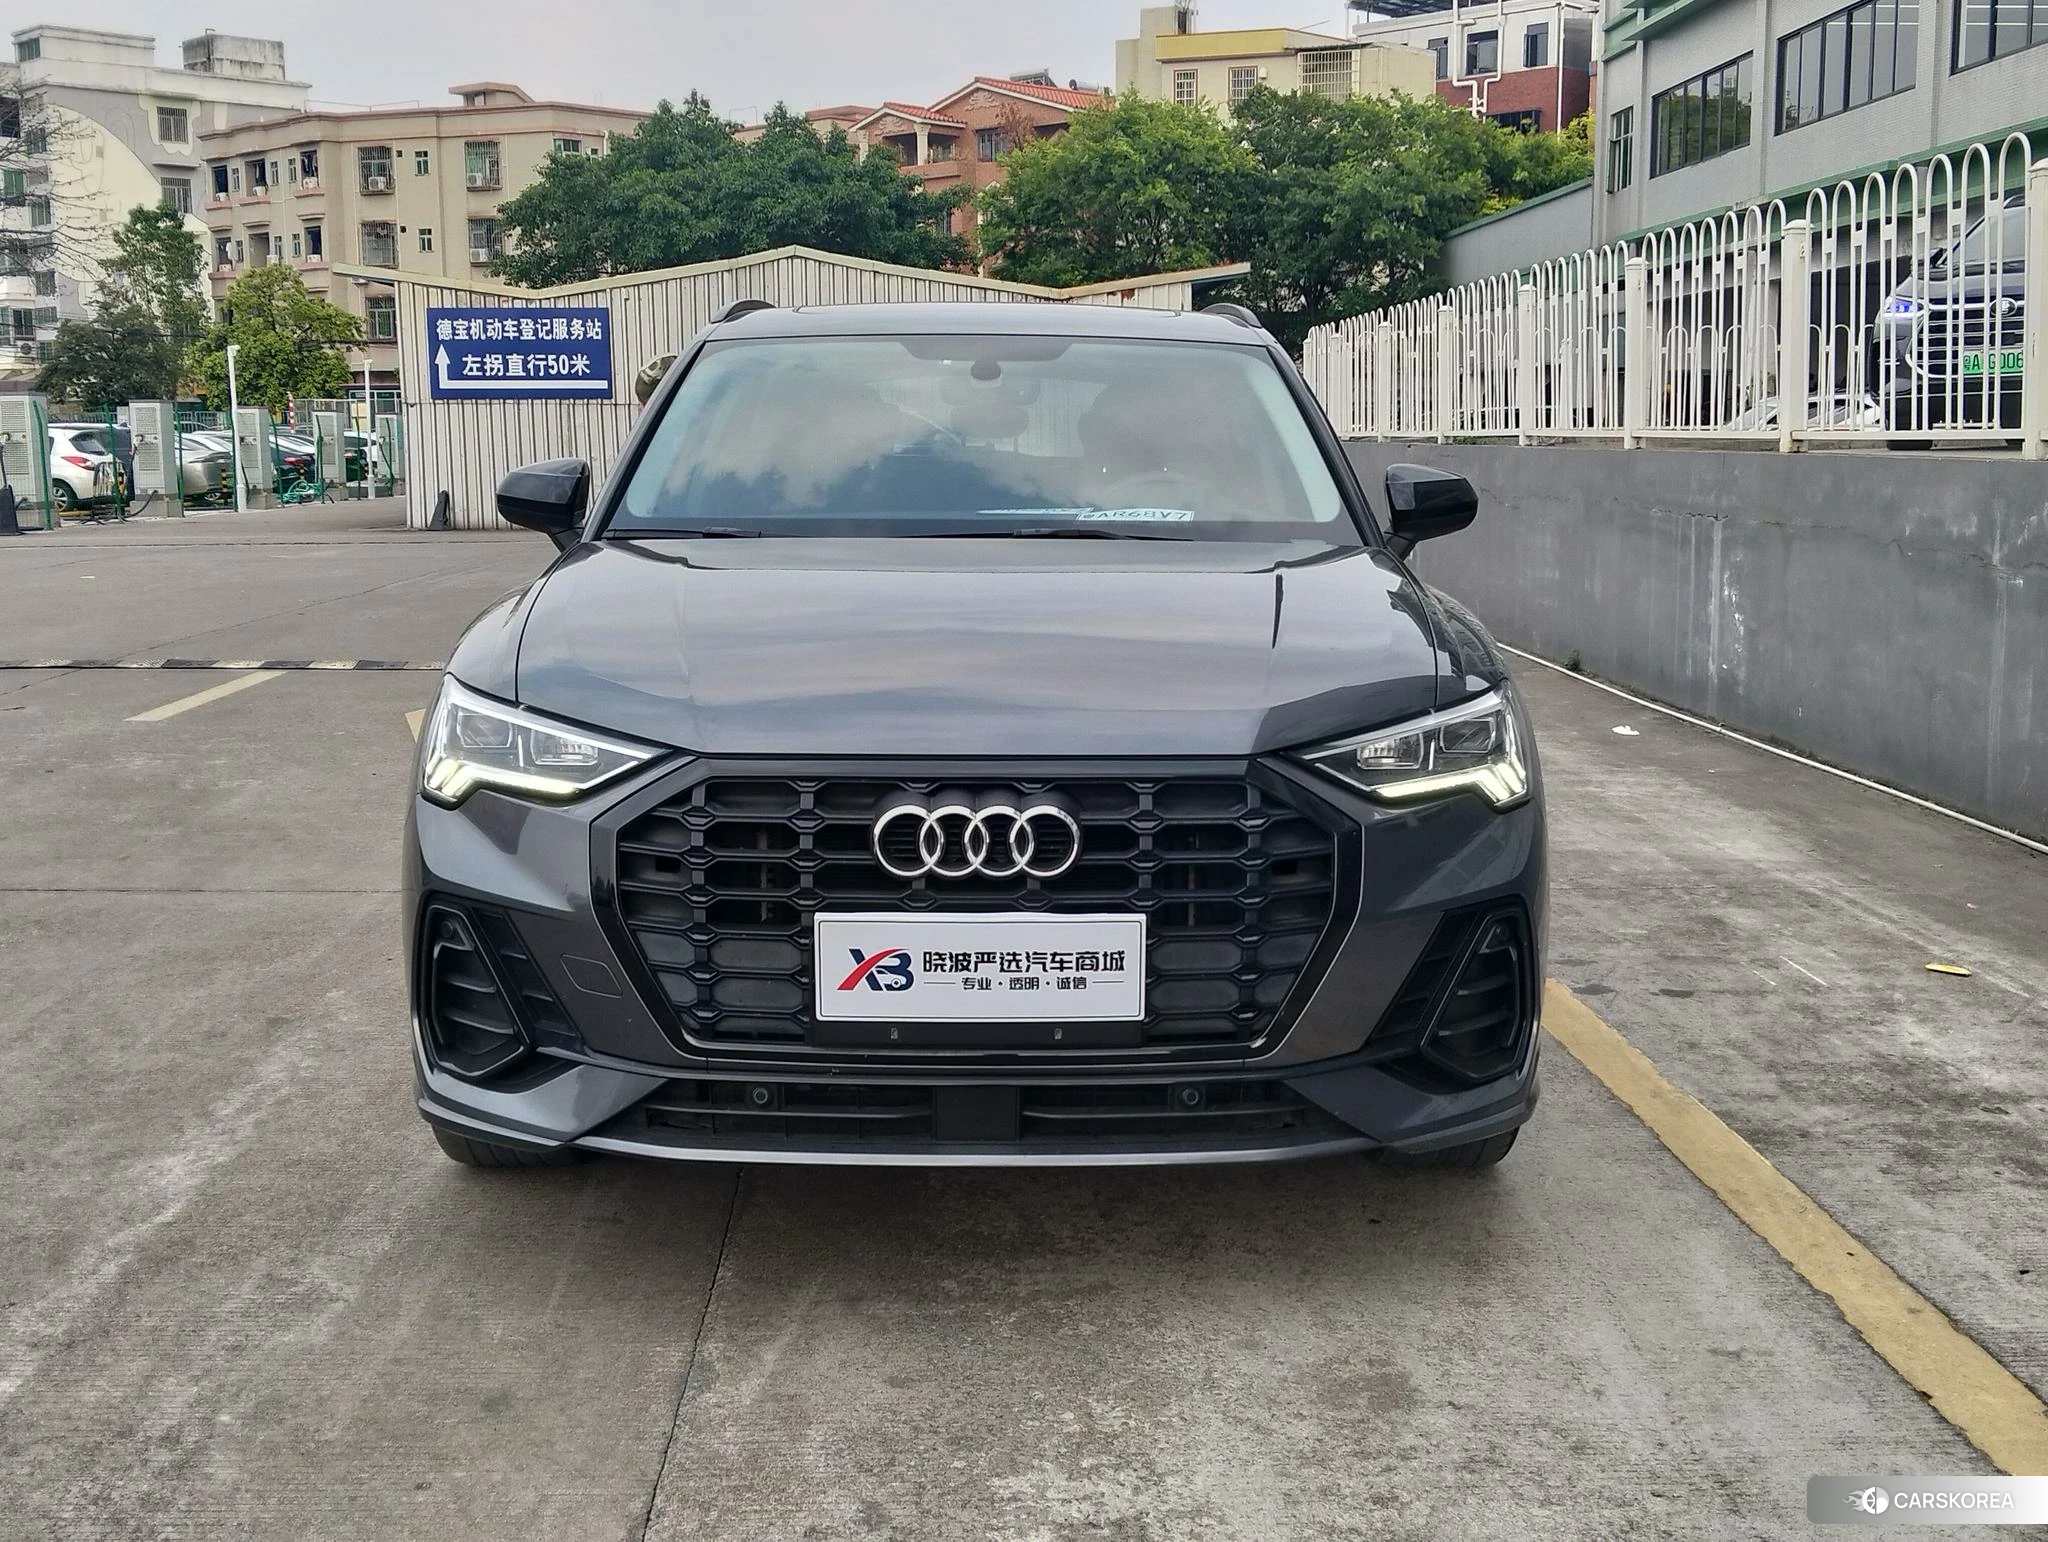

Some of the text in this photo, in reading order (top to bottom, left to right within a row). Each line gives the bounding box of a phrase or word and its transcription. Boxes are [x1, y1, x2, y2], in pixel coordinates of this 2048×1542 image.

[436, 318, 602, 341] 德宝机动车登记服务站
[462, 353, 591, 376] 左拐直行50米
[922, 950, 1125, 973] 晓波严选汽车商城
